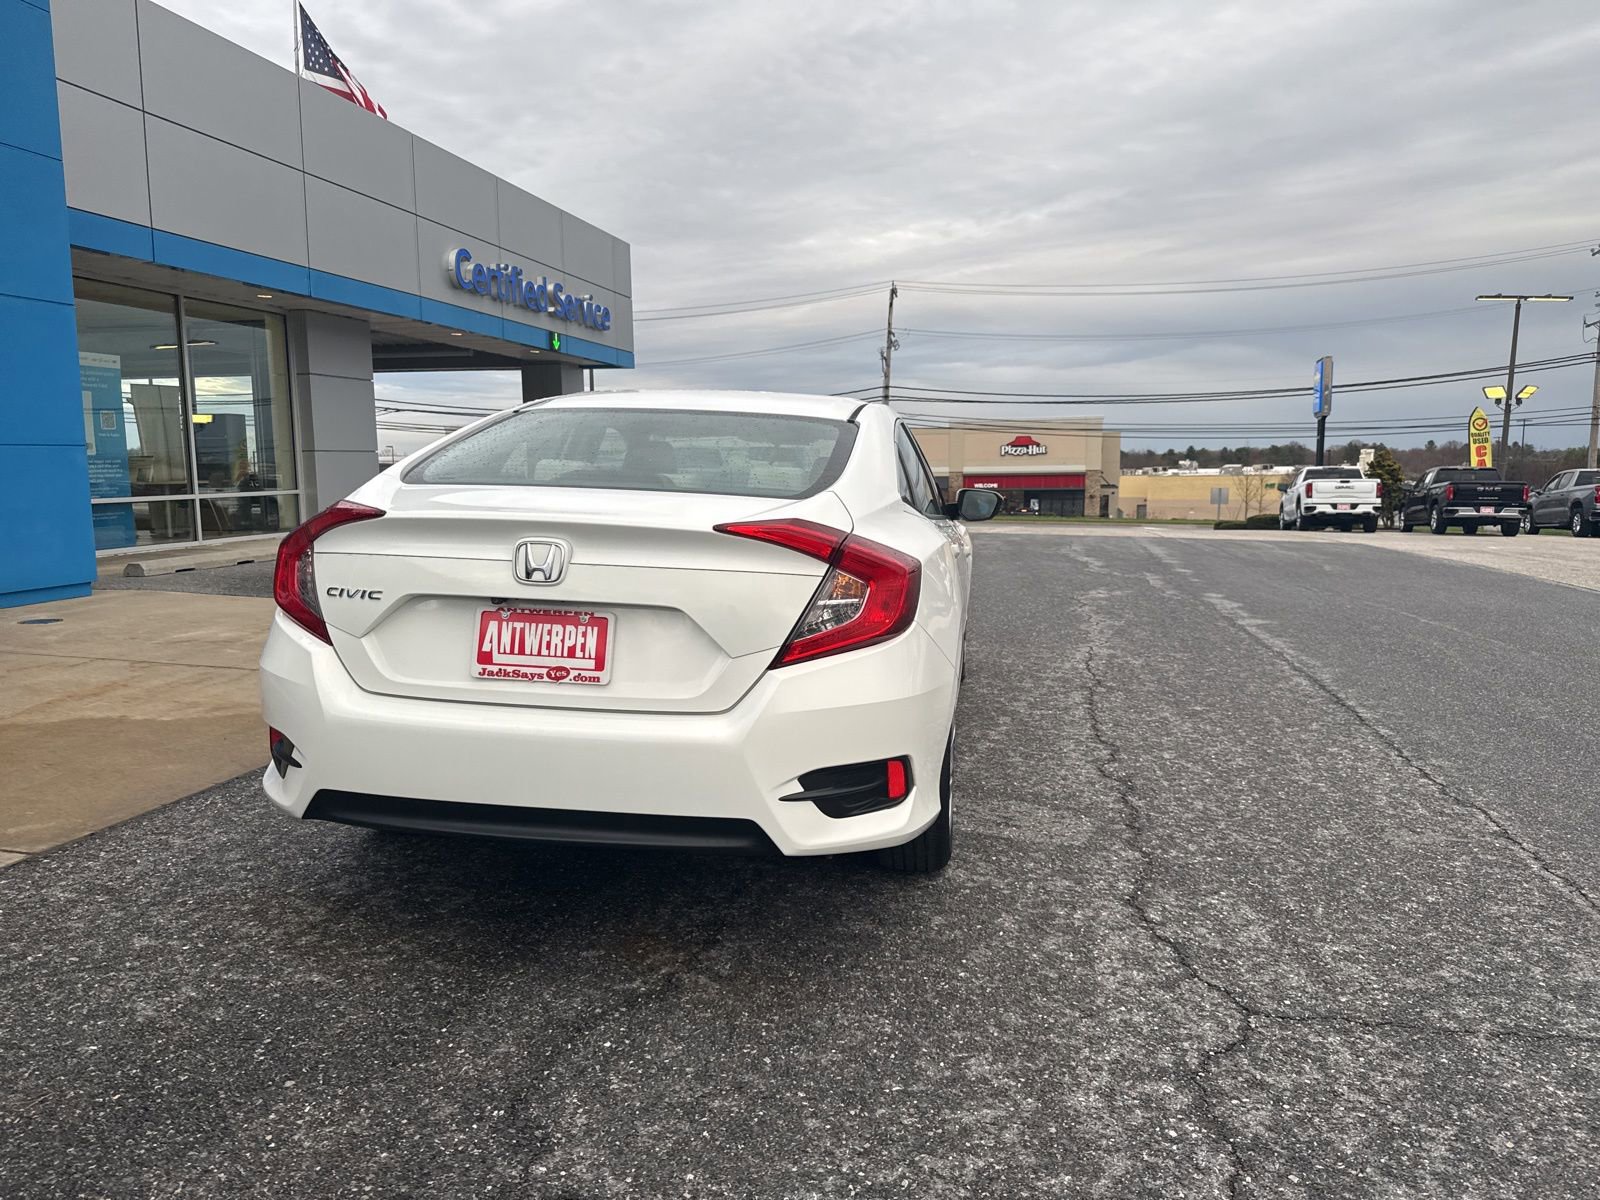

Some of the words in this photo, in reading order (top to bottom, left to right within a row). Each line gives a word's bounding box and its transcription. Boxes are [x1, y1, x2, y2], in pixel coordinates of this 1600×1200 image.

[452, 248, 548, 312] Certified
[551, 283, 611, 331] Service
[1001, 445, 1027, 455] Pizza
[1028, 444, 1047, 455] Hut
[326, 587, 383, 600] CIVIC
[482, 621, 598, 661] ANTWERPEN
